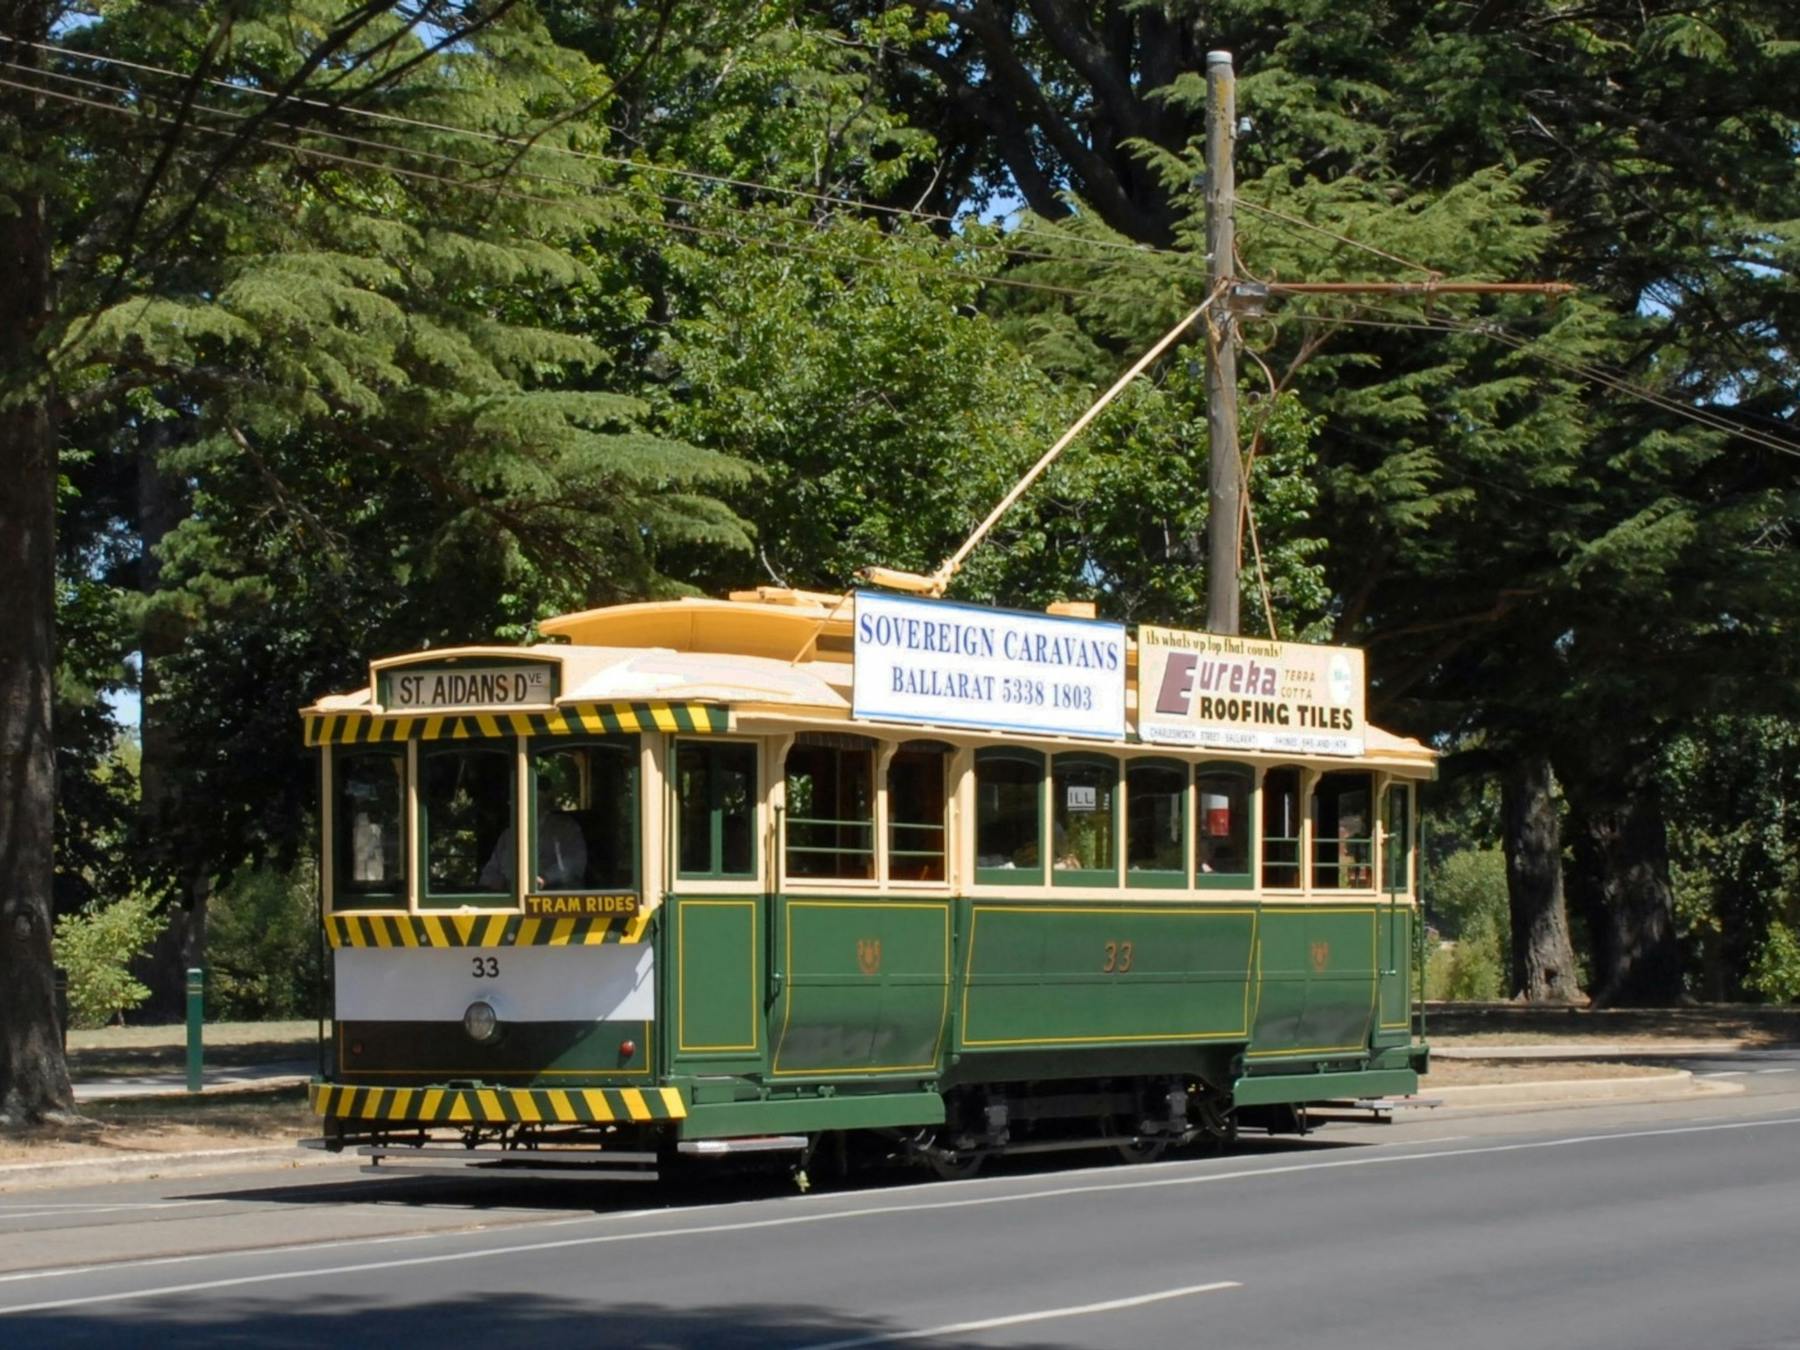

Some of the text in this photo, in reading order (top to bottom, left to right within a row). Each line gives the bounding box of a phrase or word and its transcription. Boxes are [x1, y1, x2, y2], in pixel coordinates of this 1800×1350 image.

[860, 612, 1118, 671] SOVEREIGN CARAVANS
[1193, 640, 1206, 654] up
[1224, 638, 1244, 654] that
[400, 676, 426, 704] ST.
[432, 674, 509, 704] AIDANS
[891, 665, 1093, 711] BALLARAT 5338 1803
[1155, 652, 1277, 716] Eureka
[1285, 669, 1316, 682] TERRA
[1281, 686, 1313, 699] COTTA
[1200, 696, 1353, 731] ROOFING TILES
[529, 896, 635, 913] TRAM RIDES
[472, 956, 500, 978] 33
[1103, 942, 1133, 974] 33
